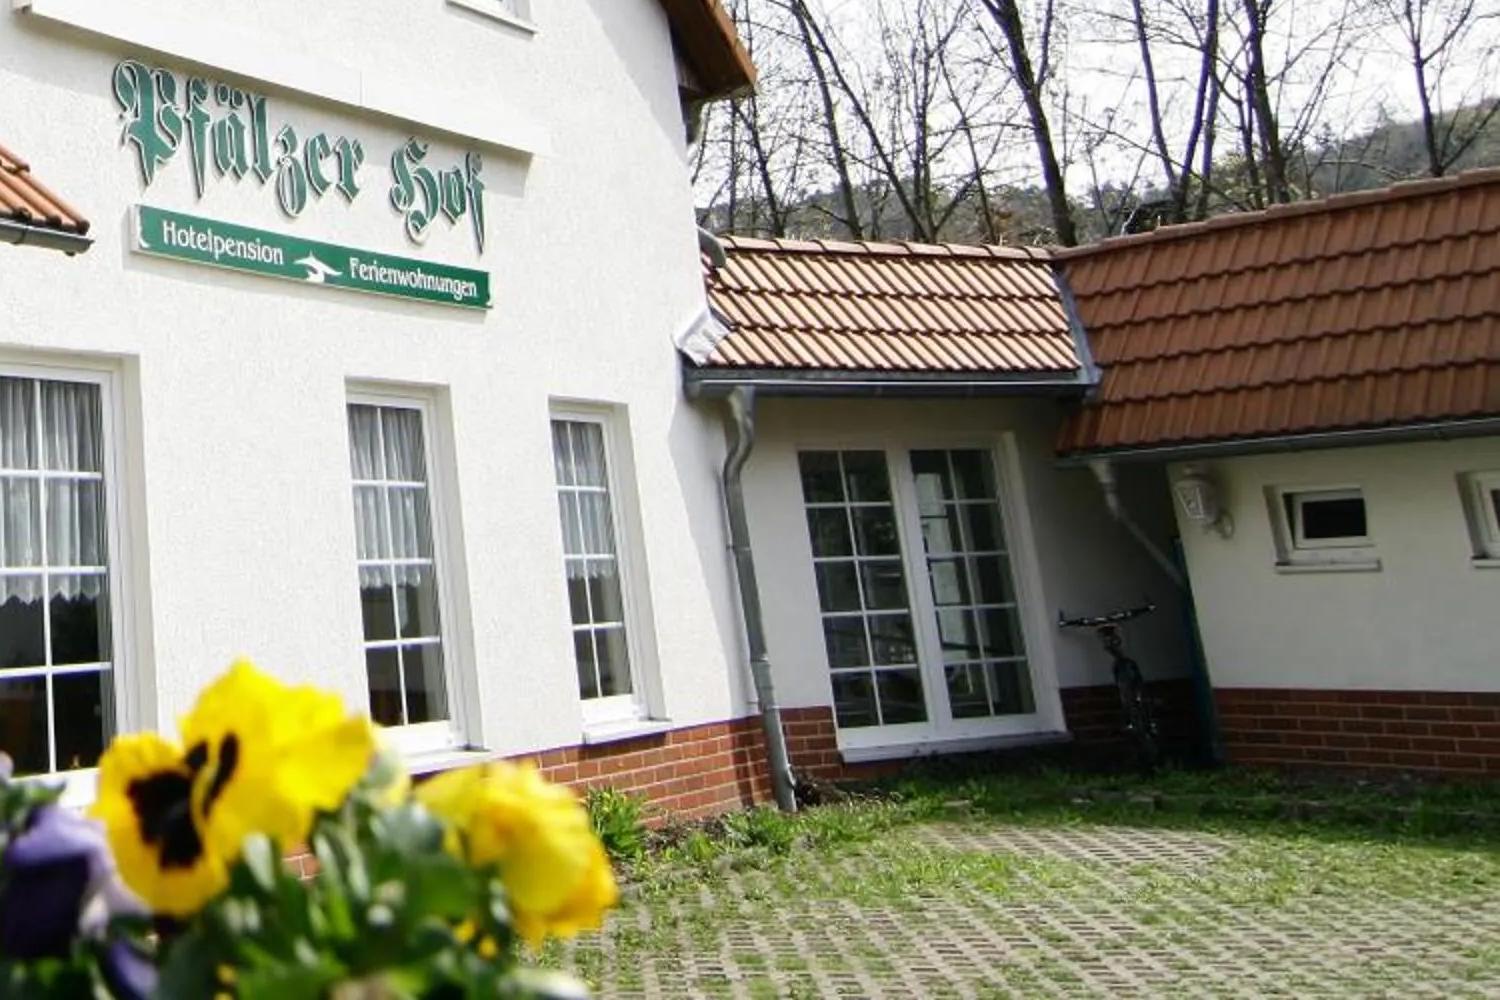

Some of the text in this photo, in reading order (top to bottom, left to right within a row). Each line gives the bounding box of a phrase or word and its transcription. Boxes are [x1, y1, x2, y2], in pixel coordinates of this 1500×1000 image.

[111, 58, 487, 258] Pfälzer Hof
[162, 219, 478, 301] Hotelpension Ferienwohnungen
